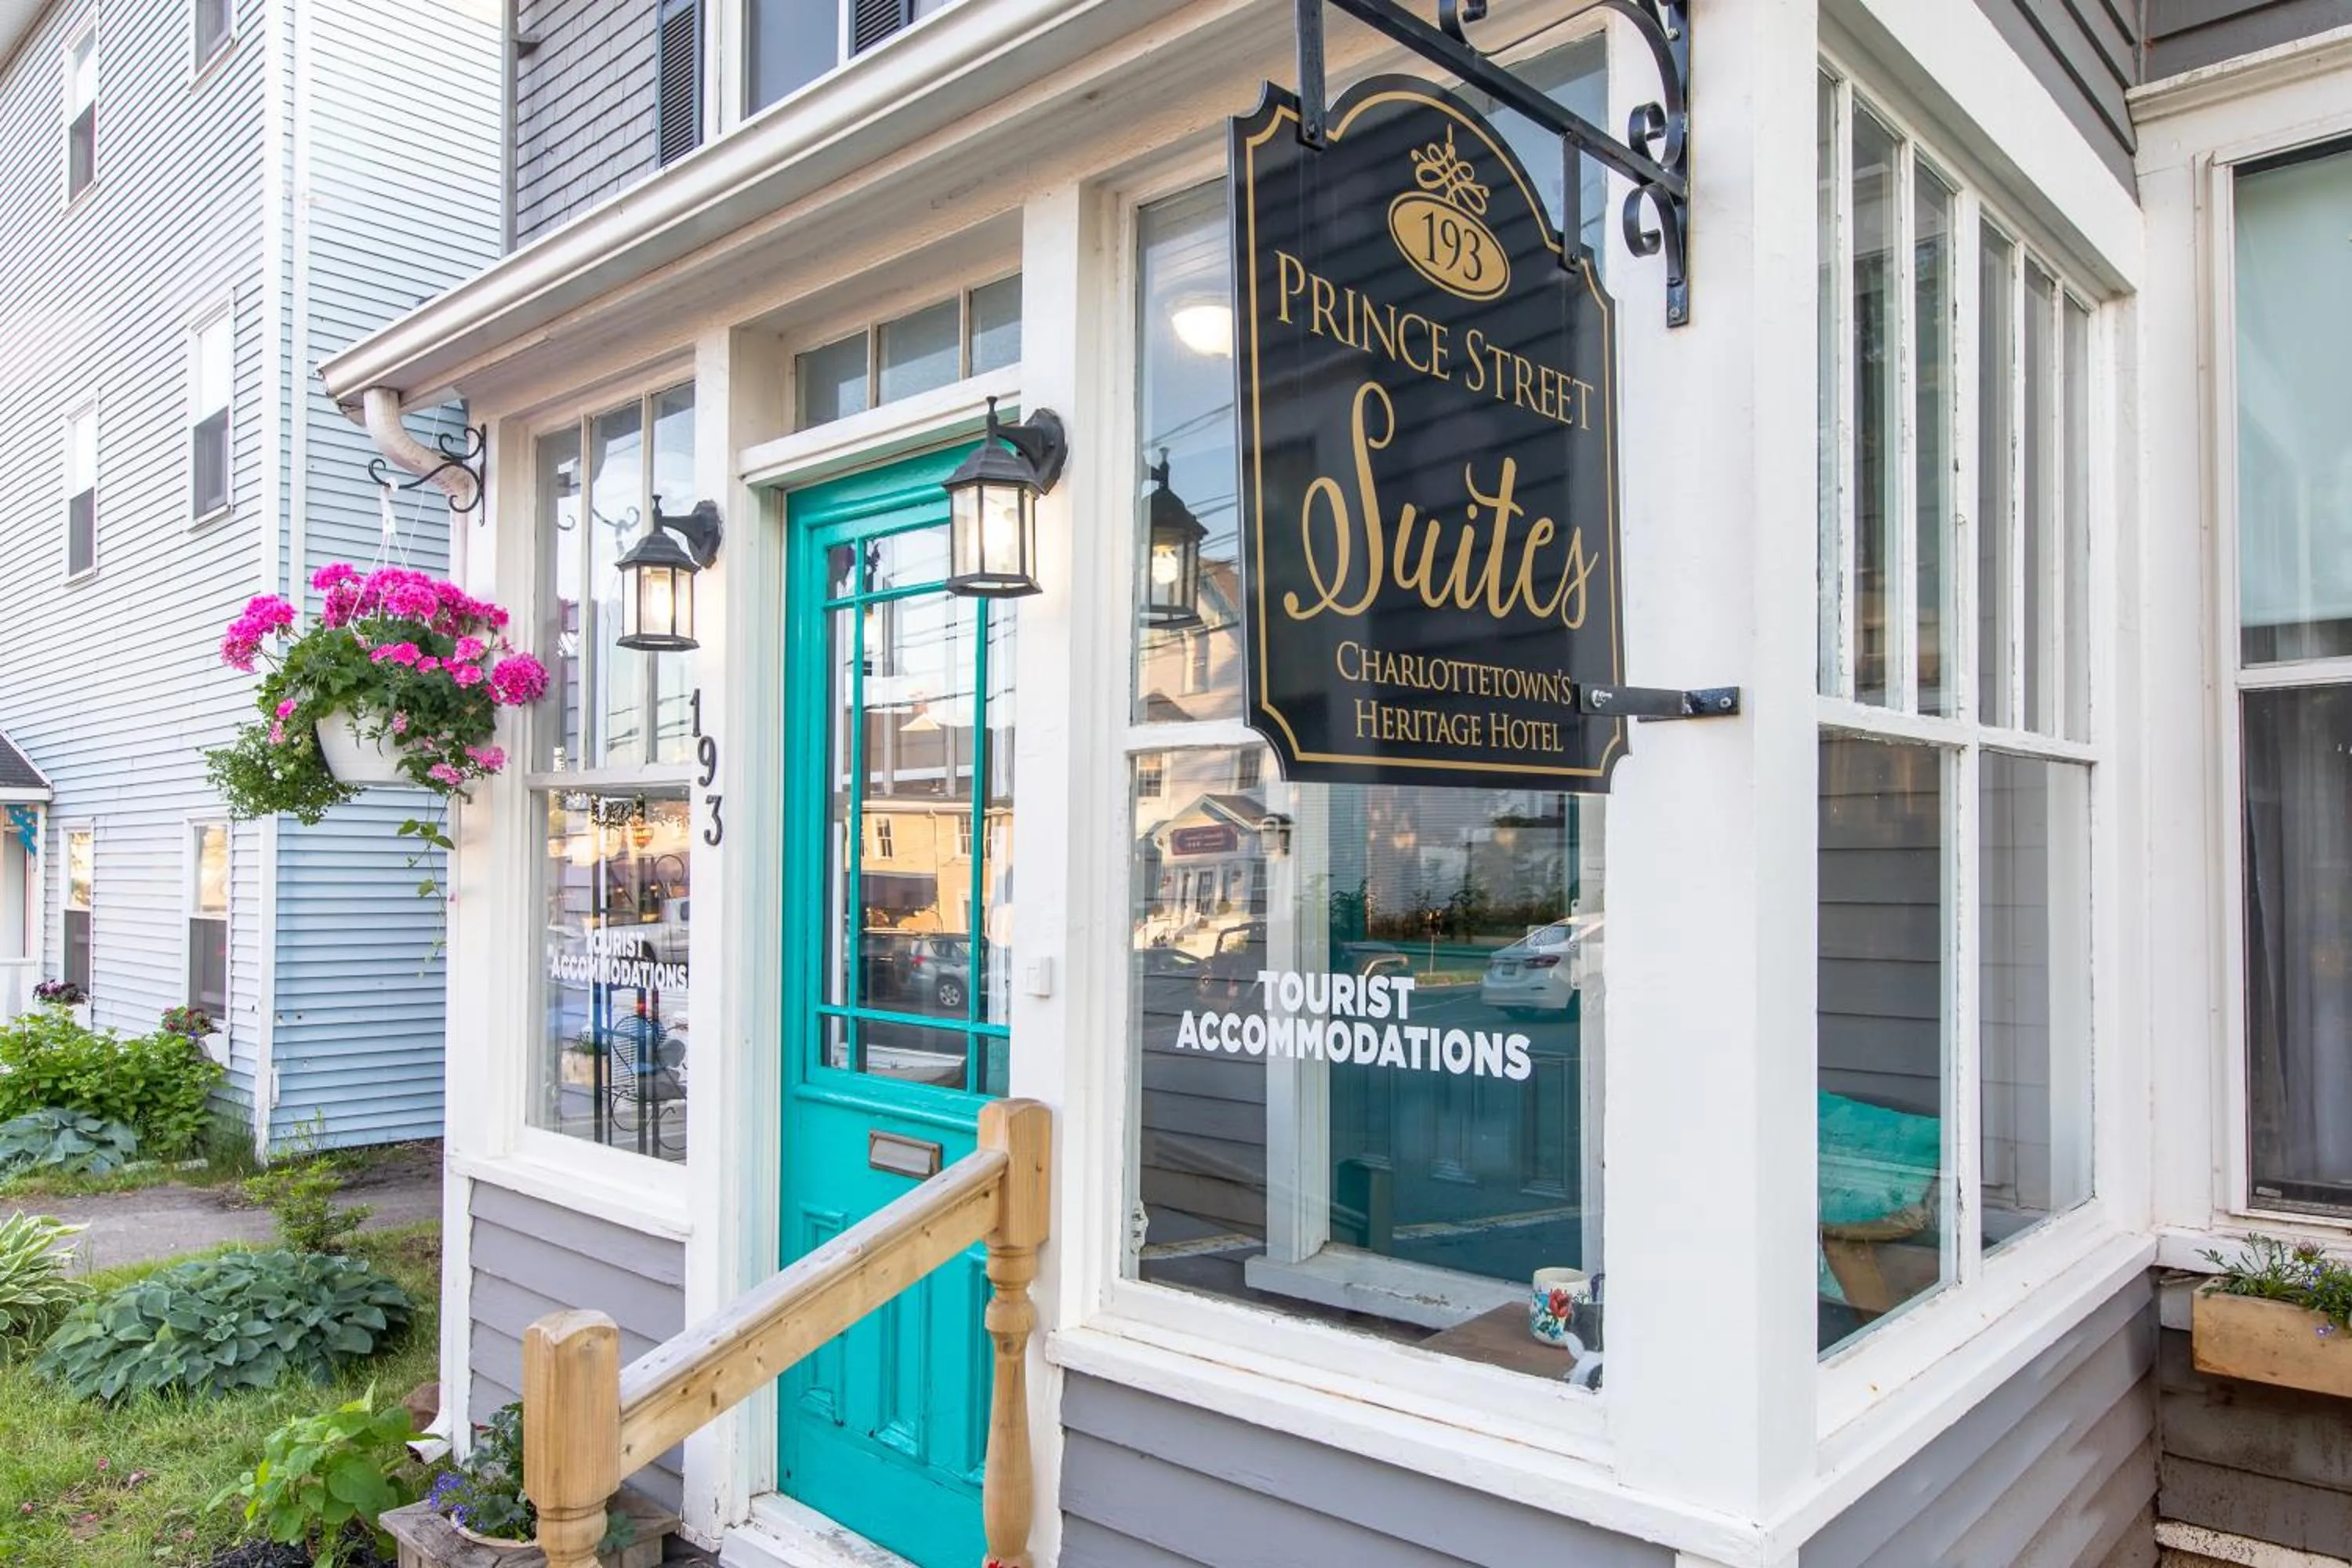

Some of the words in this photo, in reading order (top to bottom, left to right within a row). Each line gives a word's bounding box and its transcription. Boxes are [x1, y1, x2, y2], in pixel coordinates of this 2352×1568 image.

[1421, 211, 1481, 281] 193
[1276, 250, 1450, 380] PRINCE
[1466, 329, 1593, 430] STREET
[1283, 382, 1599, 629] Suites
[1336, 641, 1572, 705] CHARLOTTETOWN'S
[1356, 699, 1482, 746] HERITAGE
[1490, 711, 1563, 752] HOTEL
[551, 956, 687, 989] ACCOMMODATIONS
[586, 928, 645, 958] TOURIST
[1258, 970, 1414, 1019] TOURIST
[1176, 1011, 1531, 1080] ACCOMMODATIONS
